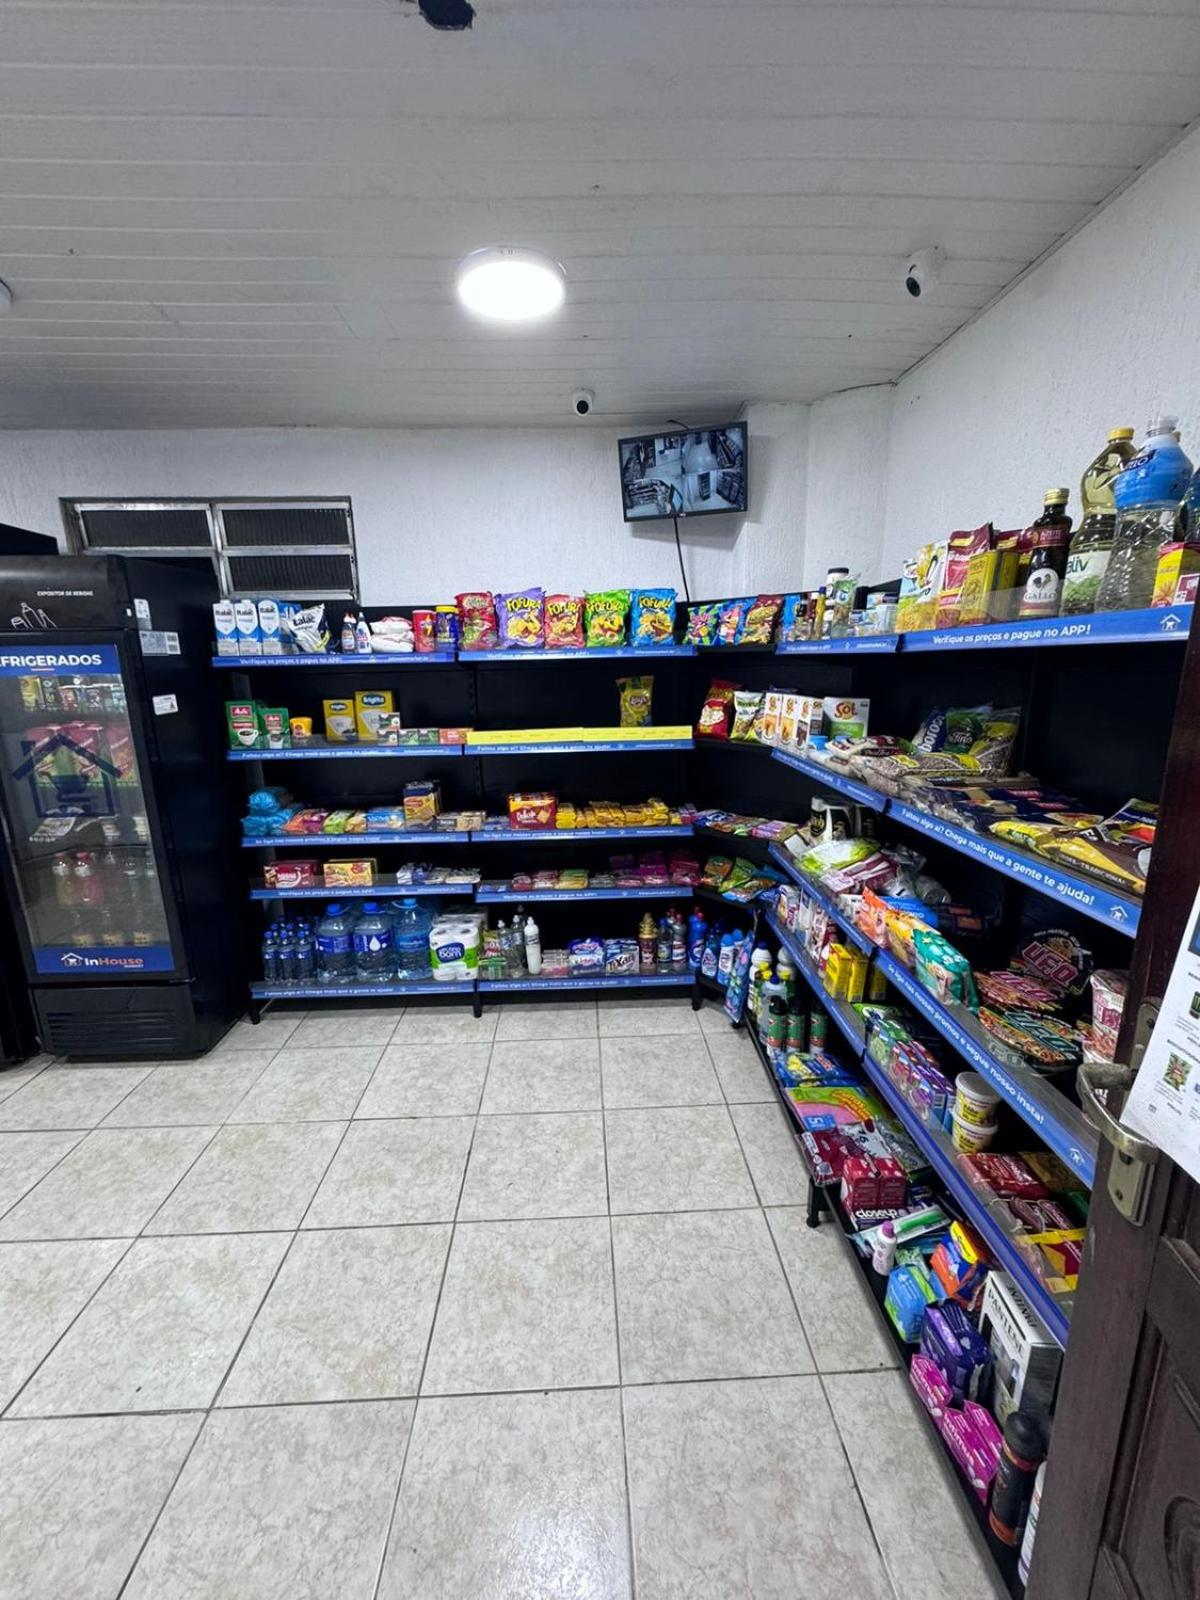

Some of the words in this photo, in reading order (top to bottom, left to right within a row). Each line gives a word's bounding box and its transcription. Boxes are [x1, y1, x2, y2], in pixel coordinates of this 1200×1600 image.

[932, 635, 964, 644] Verifique
[965, 634, 974, 642] os
[975, 632, 1002, 644] preços
[1003, 632, 1010, 640] e
[1010, 630, 1042, 641] pague
[1043, 628, 1059, 638] no
[1060, 624, 1091, 636] APP!
[0, 654, 102, 667] FRIGERADOS
[944, 829, 967, 846] Chega
[967, 841, 988, 854] mais
[988, 850, 1005, 863] que
[1005, 858, 1012, 866] a
[1012, 861, 1042, 881] gente
[1043, 875, 1056, 887] te
[1057, 882, 1095, 906] ajuda!
[84, 957, 144, 966] InHouse
[934, 1012, 960, 1040] promos
[966, 1043, 990, 1069] segue
[990, 1067, 1017, 1096] nosso
[1016, 1092, 1044, 1124] insta!
[854, 1207, 898, 1219] closeup
